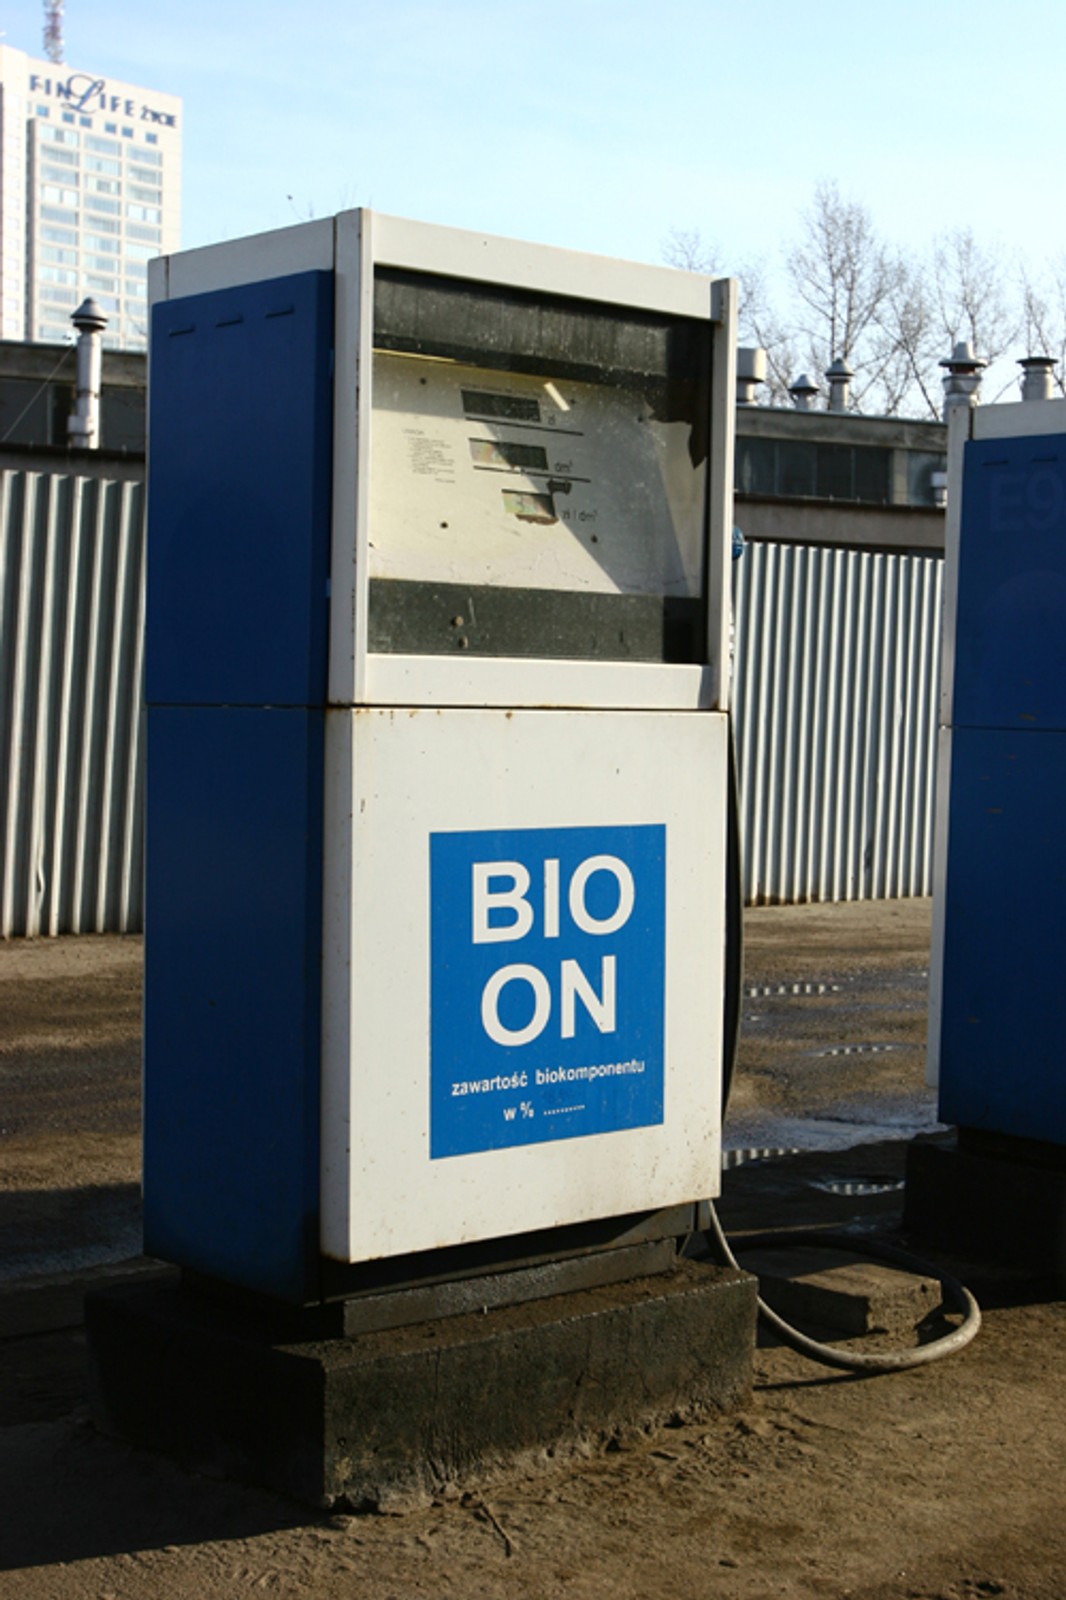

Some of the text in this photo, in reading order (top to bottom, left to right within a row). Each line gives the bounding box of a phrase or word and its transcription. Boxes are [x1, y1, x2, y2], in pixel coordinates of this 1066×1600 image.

[472, 854, 635, 944] BIO
[481, 954, 616, 1047] ON
[451, 1058, 645, 1096] zawartość biokomponentu
[503, 1108, 516, 1121] w
